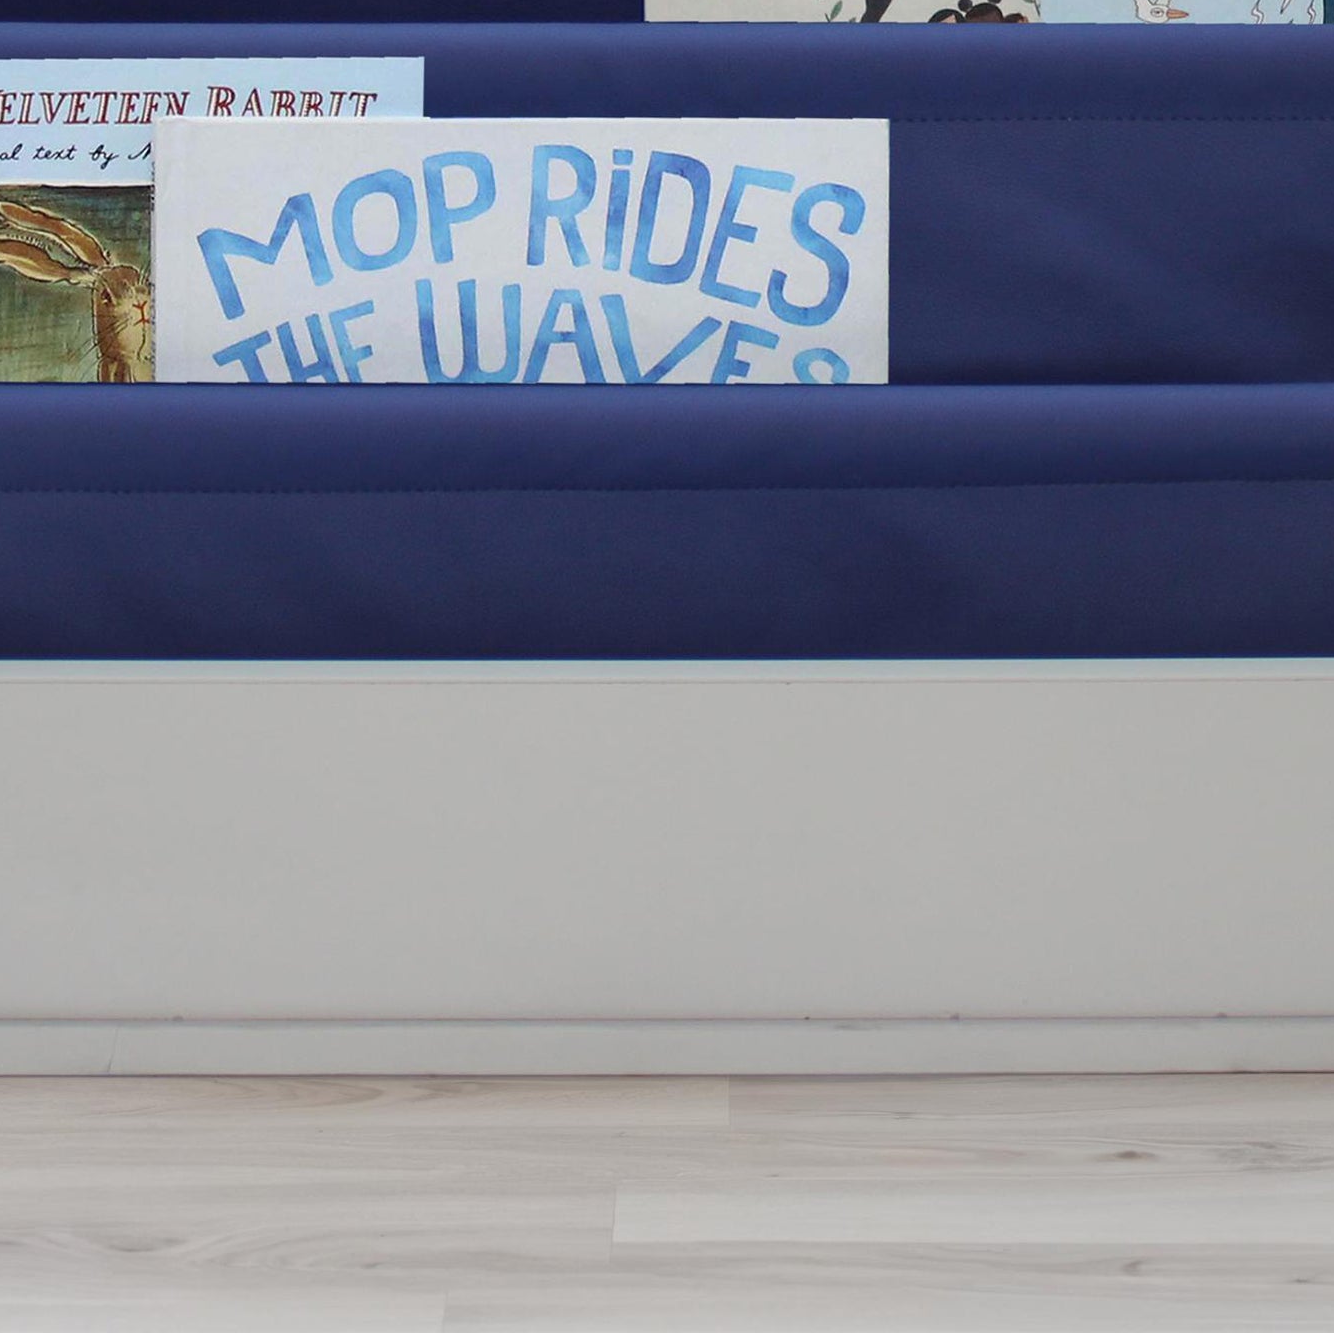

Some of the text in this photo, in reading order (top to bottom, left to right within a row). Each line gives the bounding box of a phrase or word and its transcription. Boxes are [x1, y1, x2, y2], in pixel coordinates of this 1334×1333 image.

[206, 86, 378, 117] RABBIT
[33, 145, 78, 161] text
[89, 144, 119, 170] by
[197, 150, 497, 321] MOP
